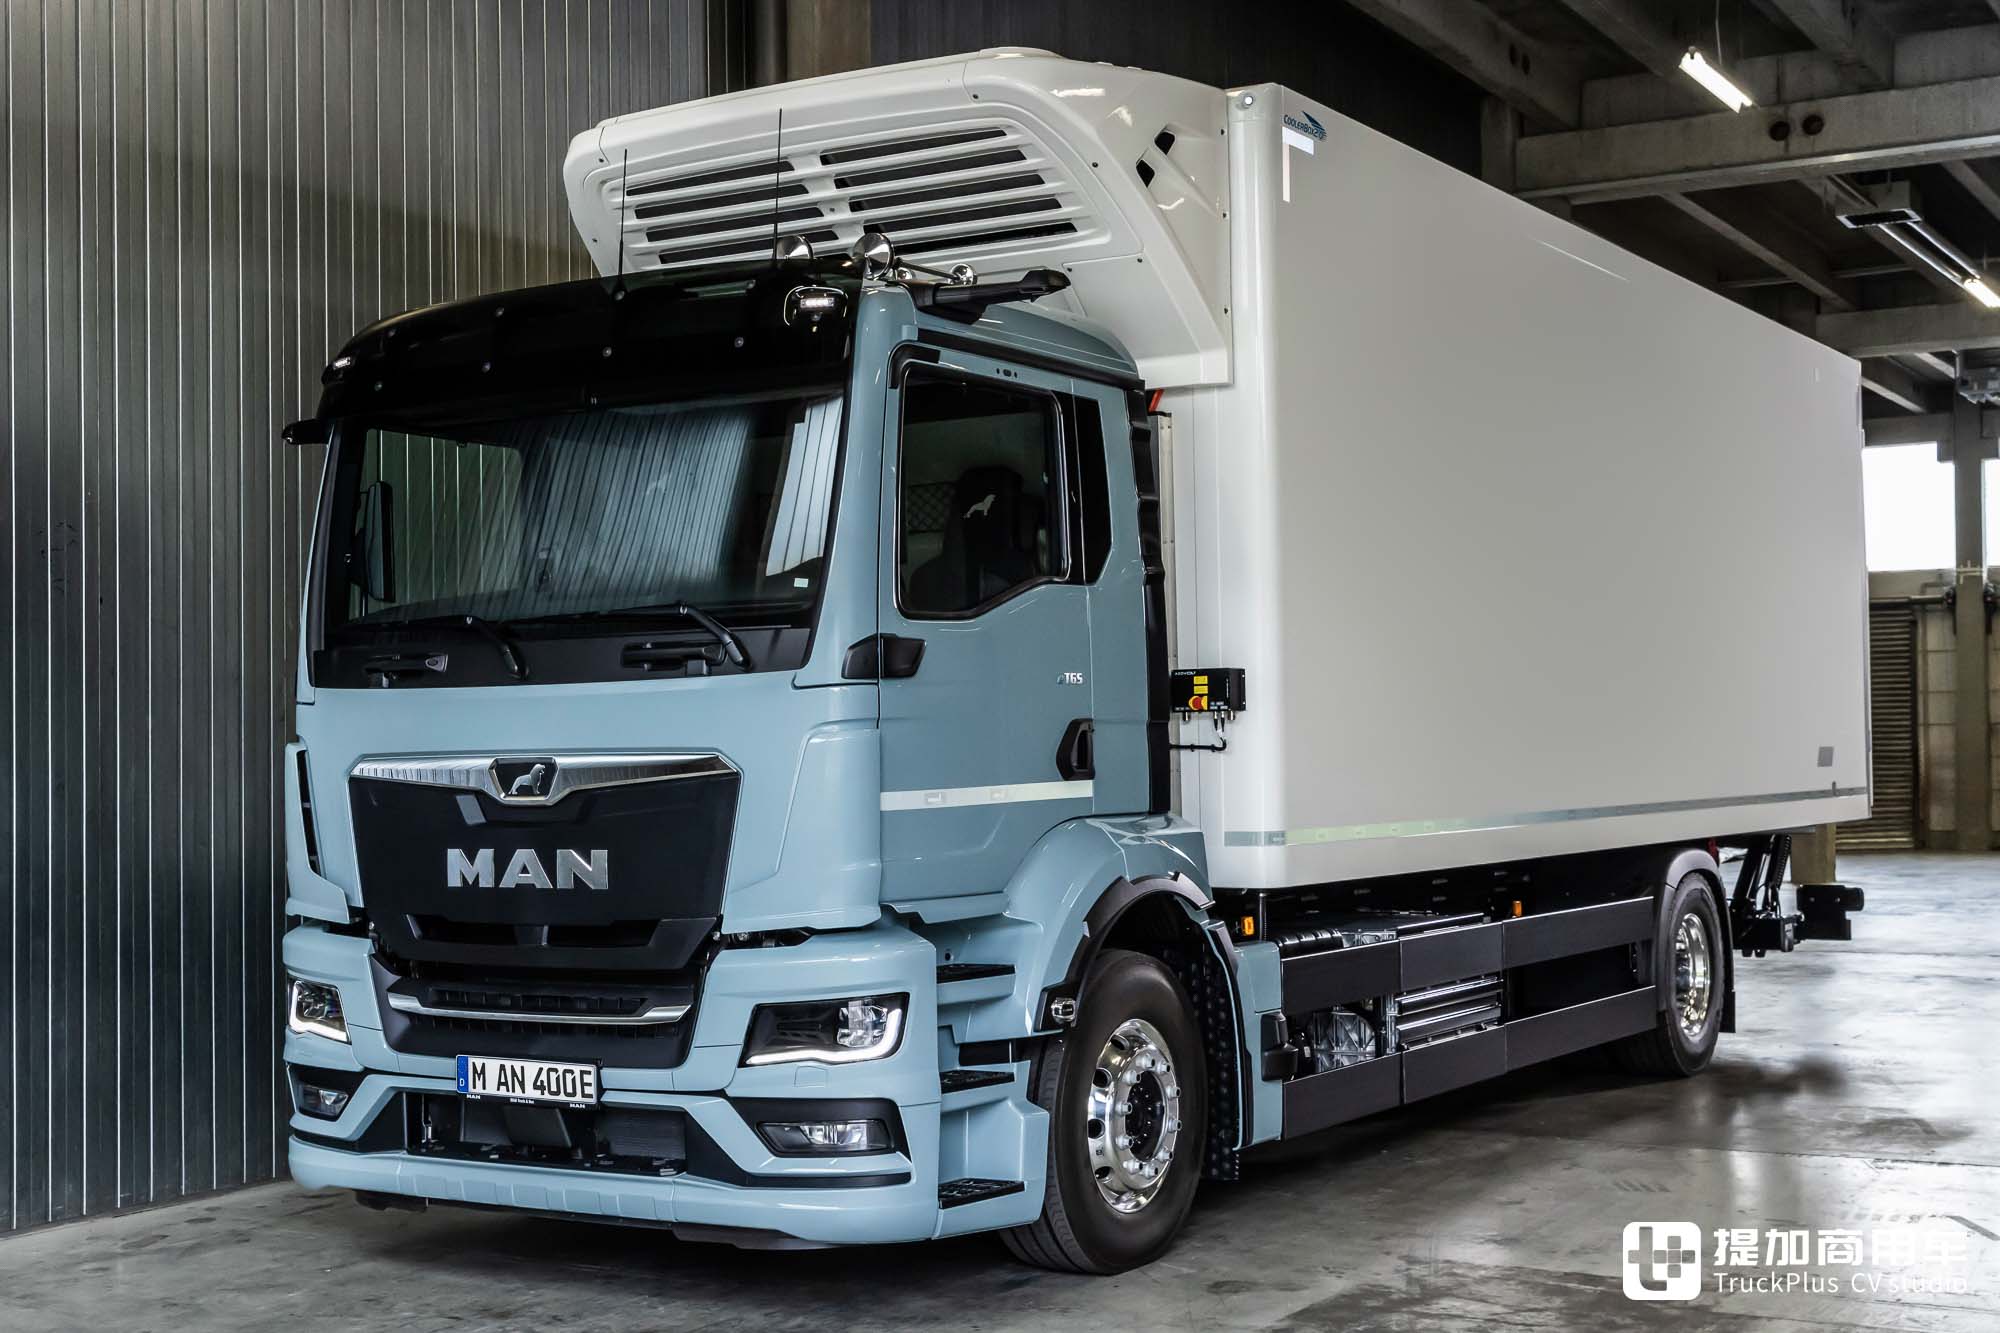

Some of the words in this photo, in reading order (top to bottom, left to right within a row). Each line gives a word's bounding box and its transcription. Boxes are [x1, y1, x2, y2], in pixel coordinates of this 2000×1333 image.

[447, 848, 608, 889] MAN
[472, 1061, 486, 1090] M
[496, 1063, 526, 1094] AN
[532, 1066, 594, 1099] 400E
